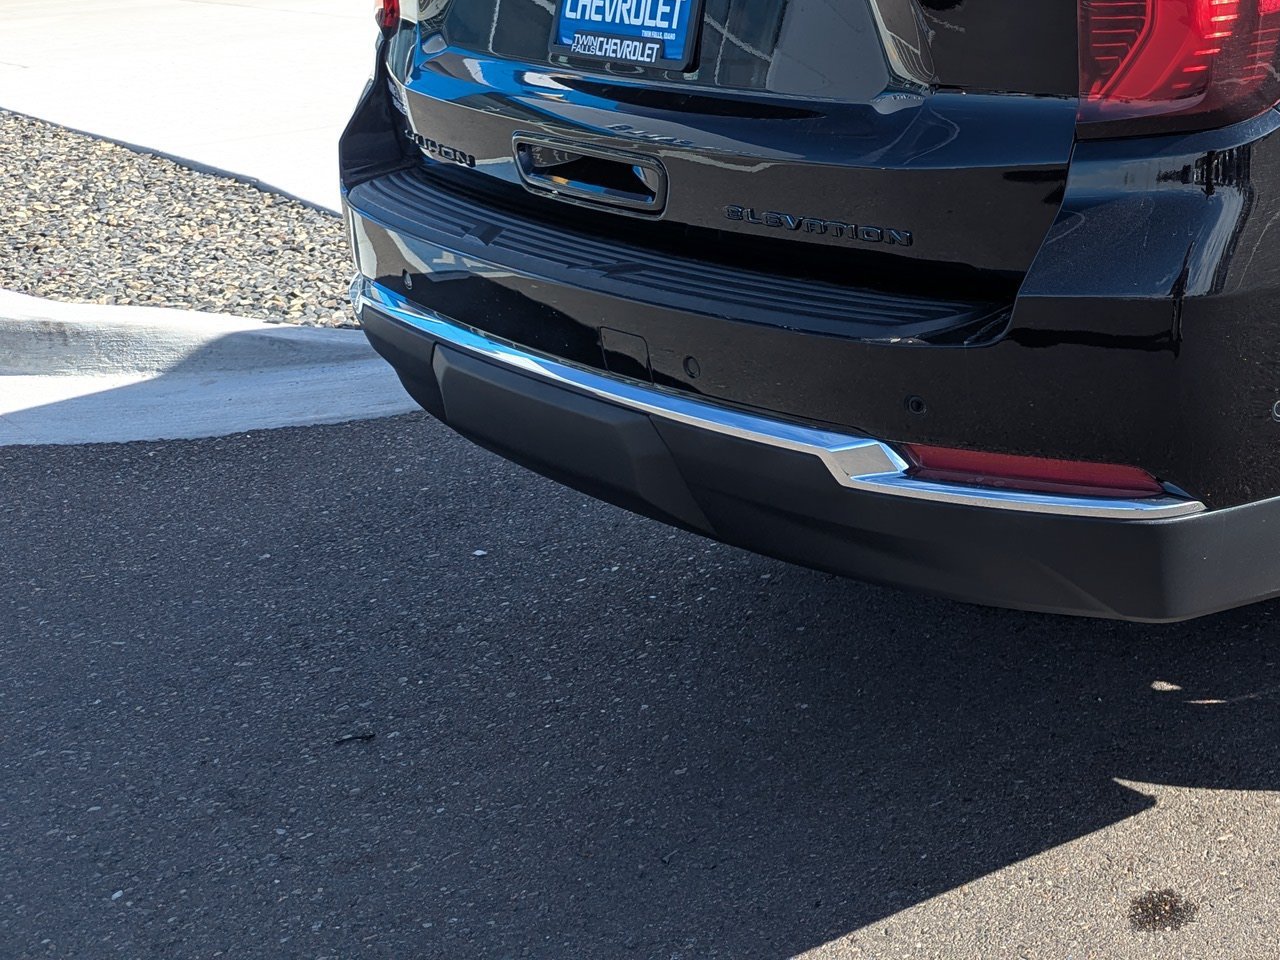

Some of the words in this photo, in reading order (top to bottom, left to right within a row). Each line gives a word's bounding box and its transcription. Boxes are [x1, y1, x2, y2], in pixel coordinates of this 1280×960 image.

[571, 44, 597, 55] FALLS
[573, 34, 598, 47] TWIN
[595, 37, 660, 63] CHEVROLET
[723, 204, 914, 247] ELEVATION
